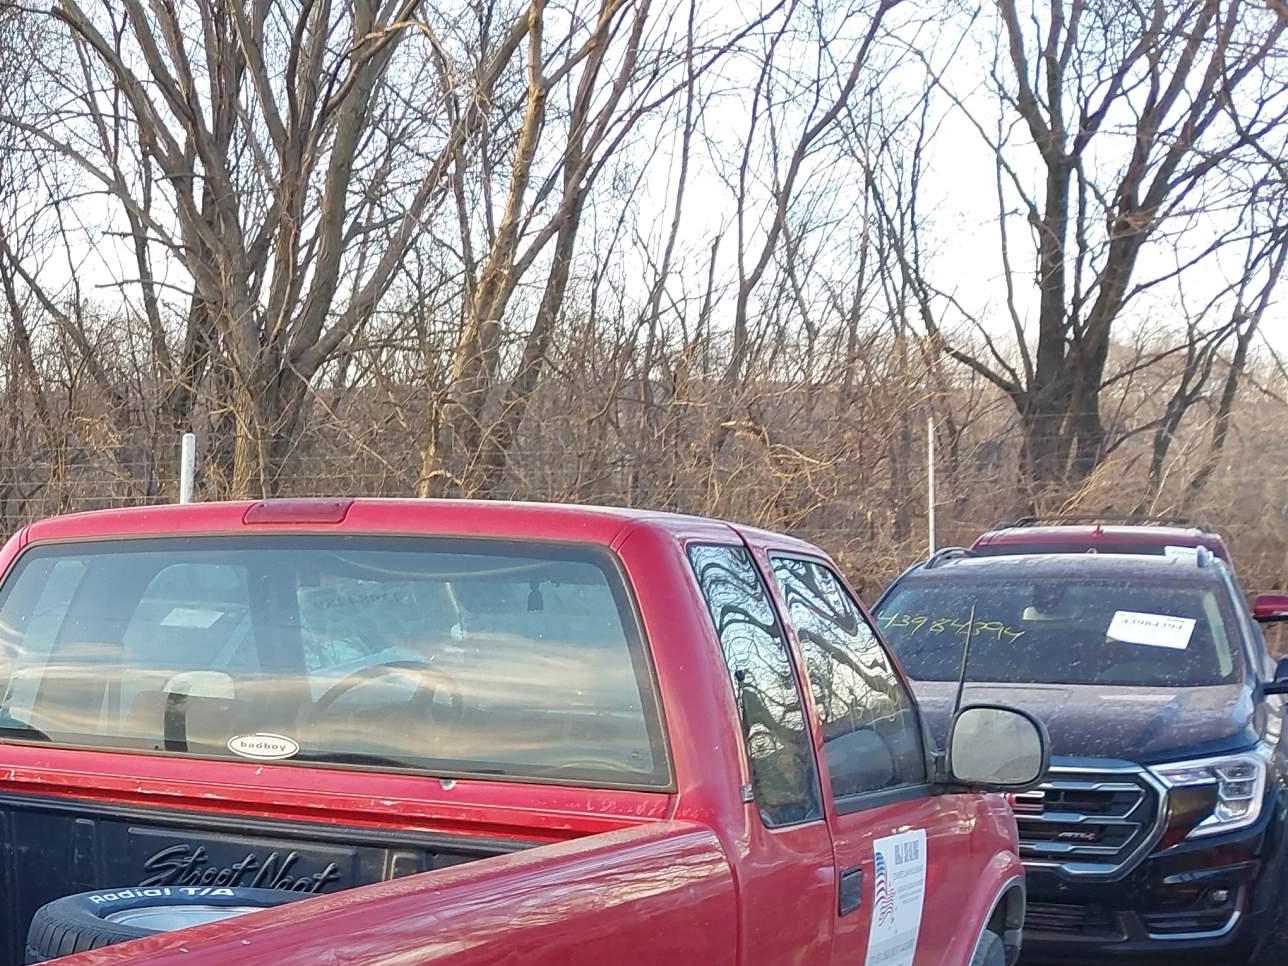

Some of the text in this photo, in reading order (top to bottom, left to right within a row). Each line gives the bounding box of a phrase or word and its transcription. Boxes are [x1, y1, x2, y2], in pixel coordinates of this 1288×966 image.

[240, 741, 286, 752] badboy
[89, 887, 234, 903] Radial T/A
